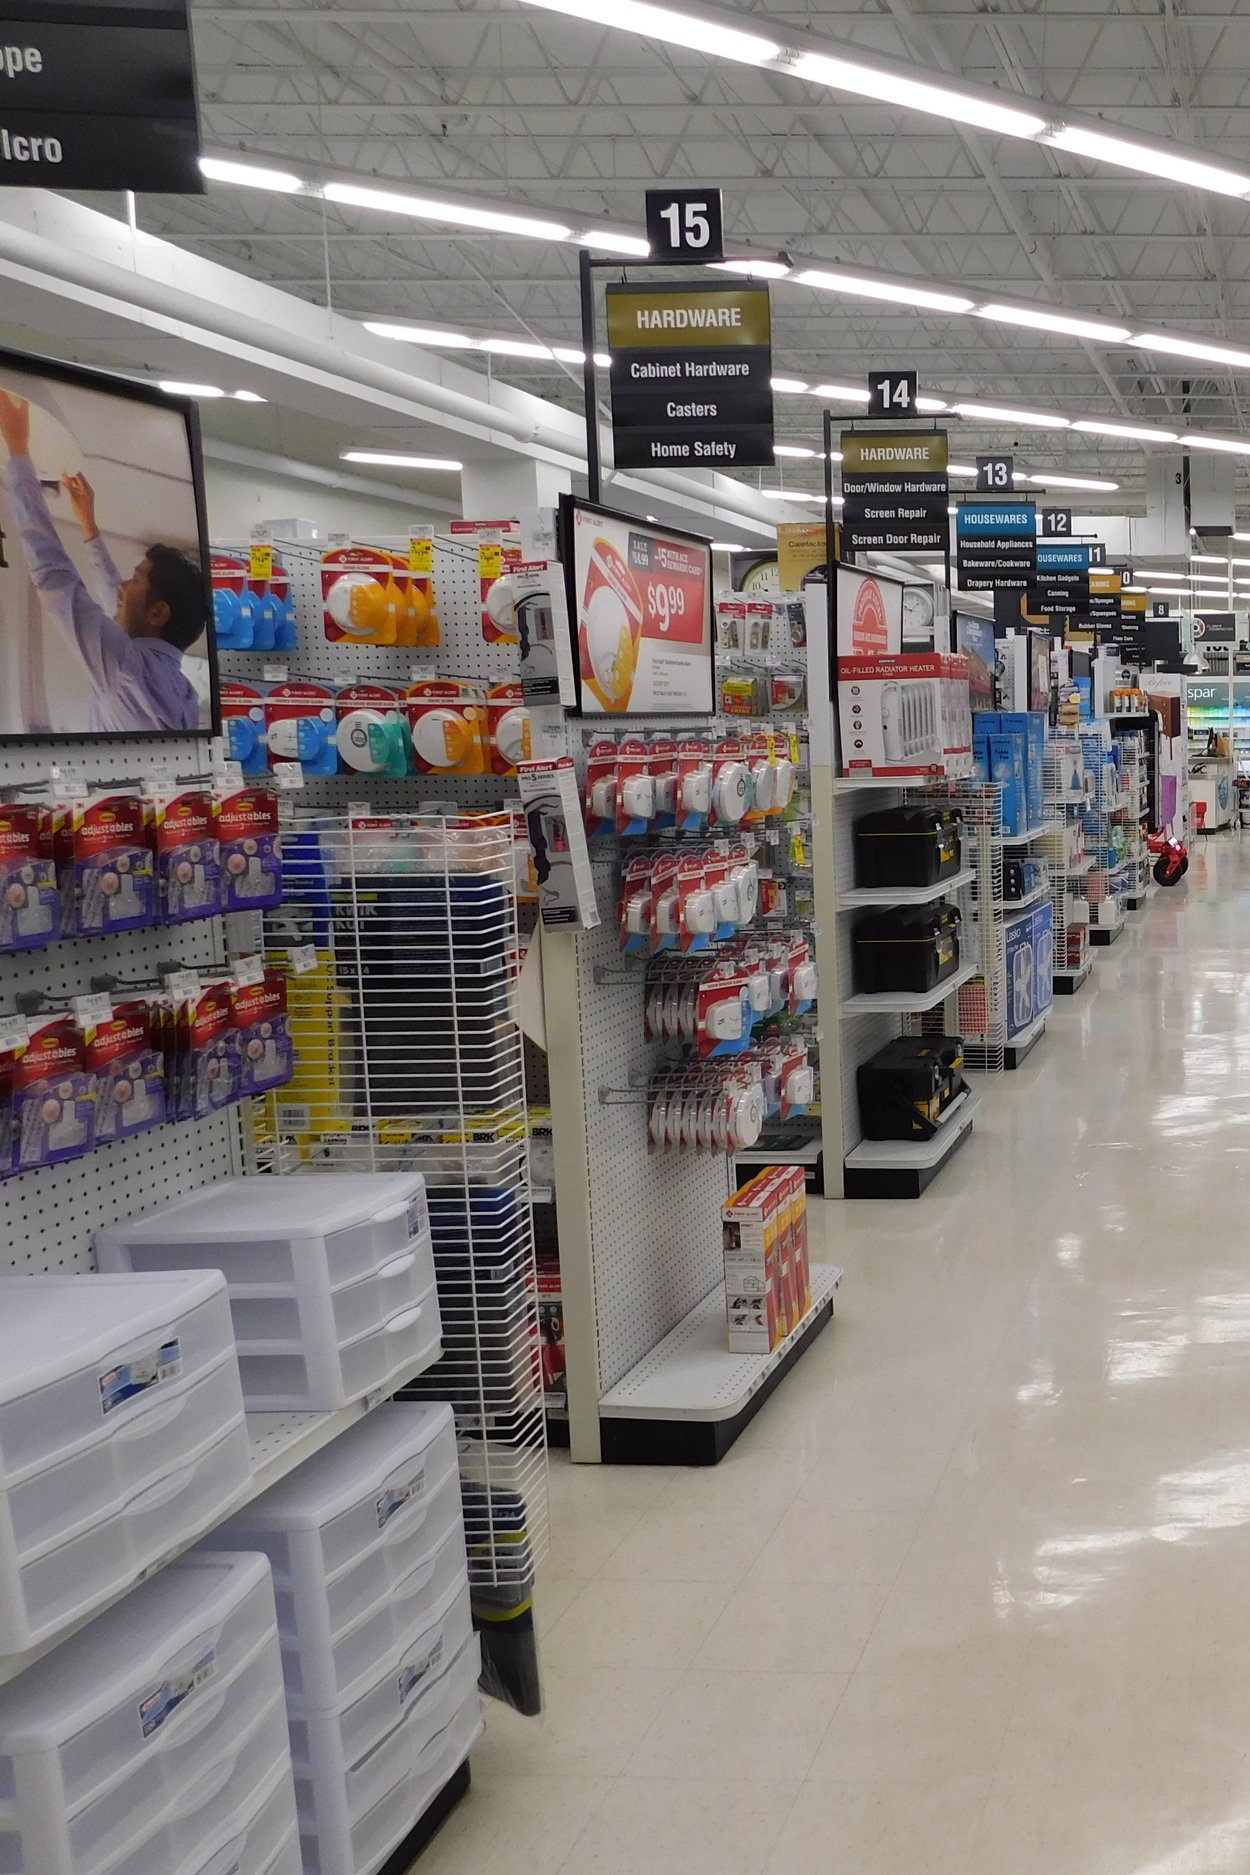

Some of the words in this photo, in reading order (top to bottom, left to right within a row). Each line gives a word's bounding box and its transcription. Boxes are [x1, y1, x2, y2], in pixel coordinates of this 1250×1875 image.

[0, 46, 43, 78] pe
[660, 203, 710, 248] 15
[637, 308, 741, 329] HARDWARE
[631, 363, 681, 378] Cabinet
[685, 362, 749, 377] Hardware
[877, 380, 910, 408] 14
[666, 402, 717, 417] Casters
[651, 442, 689, 457] Home
[694, 441, 736, 458] Safety
[860, 447, 929, 460] HARDWARE
[983, 463, 1007, 485] 13
[844, 482, 901, 494] Door/Window
[904, 481, 946, 493] Hardware
[864, 509, 896, 518] Screen
[898, 508, 927, 520] Repair
[964, 514, 1027, 524] HOUSEWARES
[1048, 514, 1066, 531] 12
[852, 534, 883, 544] Screen
[886, 534, 908, 544] Door
[910, 533, 941, 545] Repair
[960, 540, 995, 548] Household
[997, 540, 1033, 549] Appliances
[963, 560, 1030, 568] Bakeware/Cookware
[967, 579, 993, 588] Drapery
[995, 579, 1027, 587] Hardware
[876, 665, 908, 673] RADIATOR
[909, 664, 935, 672] HEATER
[164, 817, 207, 830] adjustables
[218, 811, 271, 824] adjustables
[81, 822, 133, 837] adjustables
[235, 993, 280, 1011] adjustables
[195, 1007, 228, 1027] adjustables
[94, 1027, 144, 1047] adjustables
[22, 1047, 77, 1063] adjustables
[473, 1132, 494, 1142] BRK
[532, 1128, 552, 1137] BRK
